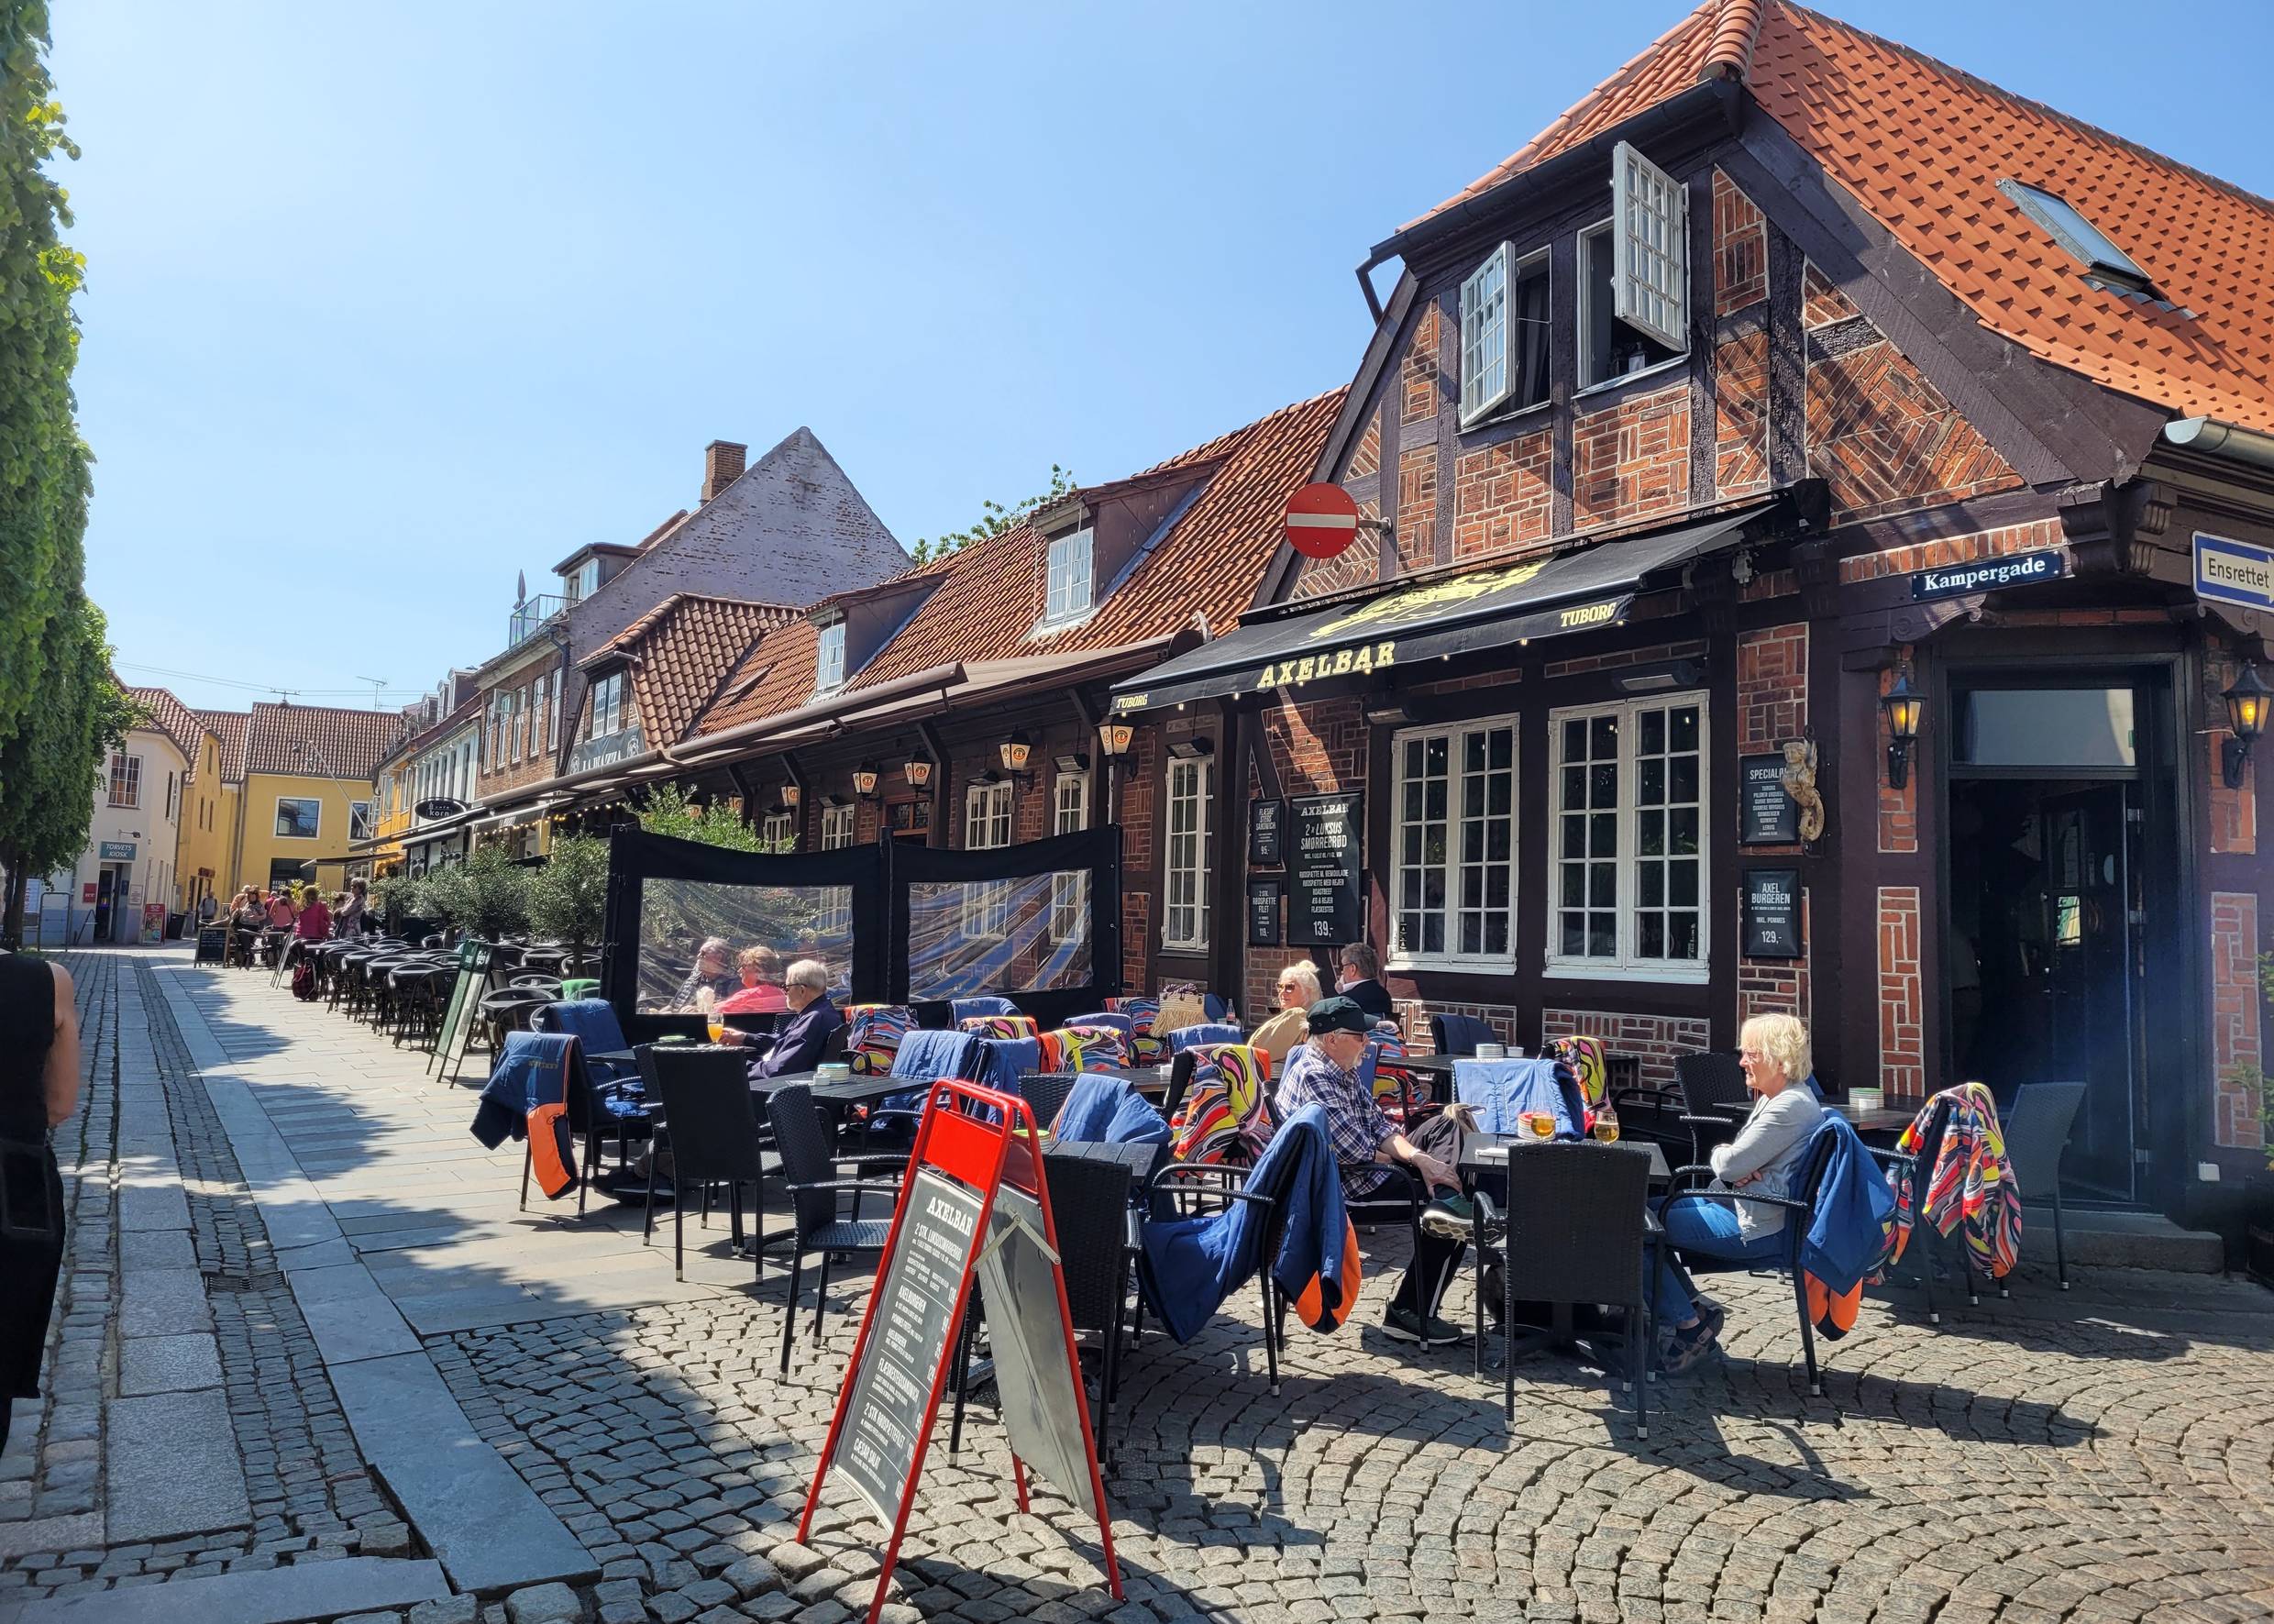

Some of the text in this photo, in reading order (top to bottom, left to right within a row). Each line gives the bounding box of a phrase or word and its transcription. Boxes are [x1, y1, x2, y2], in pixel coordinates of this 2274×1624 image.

[1925, 558, 2046, 591] Kampergade
[2208, 557, 2269, 589] Ensrettet
[1561, 602, 1617, 627] TUBORG
[1257, 641, 1396, 689] AXELBAR
[1116, 693, 1149, 709] TUBORG
[1300, 803, 1349, 816] AXELBAR
[1305, 823, 1310, 835] 2
[1316, 821, 1342, 835] LUKSUS
[1300, 834, 1347, 850] SMØRREBRØD
[1761, 883, 1780, 893] AXEL
[1253, 897, 1276, 905] RØDSPÆTTE
[1751, 893, 1791, 903] BURGEREN
[1313, 921, 1333, 938] 139,-
[1761, 931, 1782, 945] 129,-
[926, 1197, 973, 1237] AXELBAR
[914, 1221, 920, 1235] 2
[864, 1402, 870, 1416] 2
